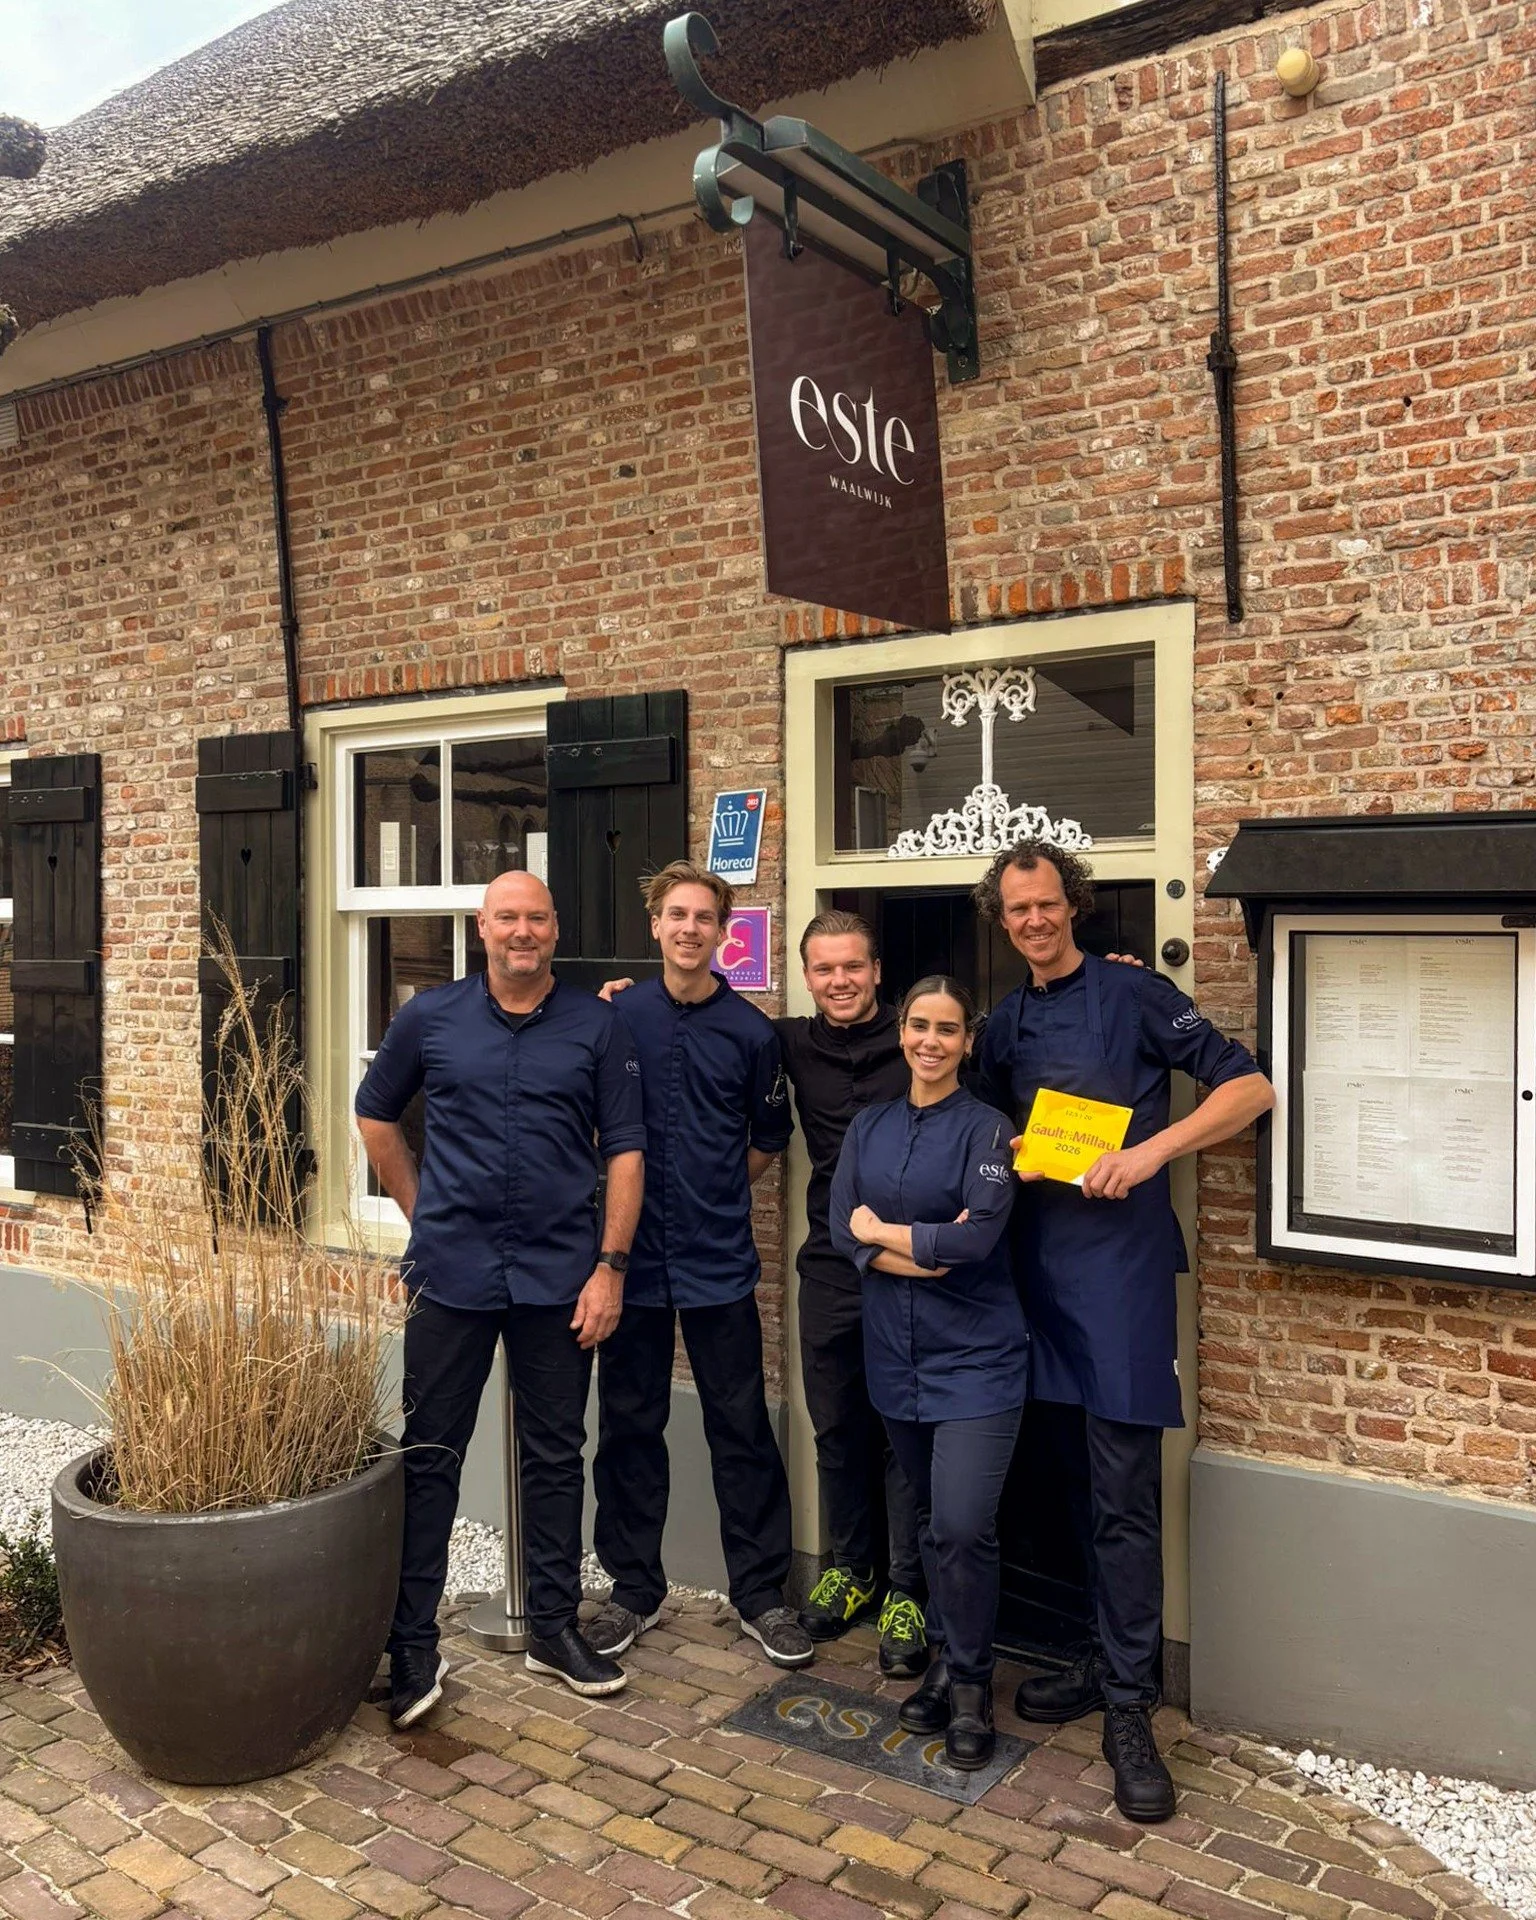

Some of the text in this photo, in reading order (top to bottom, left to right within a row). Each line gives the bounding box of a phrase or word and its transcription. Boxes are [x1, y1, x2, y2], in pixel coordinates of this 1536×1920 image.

[790, 376, 915, 485] este
[829, 474, 893, 509] WAALWIJK
[712, 856, 753, 871] Horeca
[1055, 1142, 1081, 1156] 2026
[979, 1163, 1010, 1183] este
